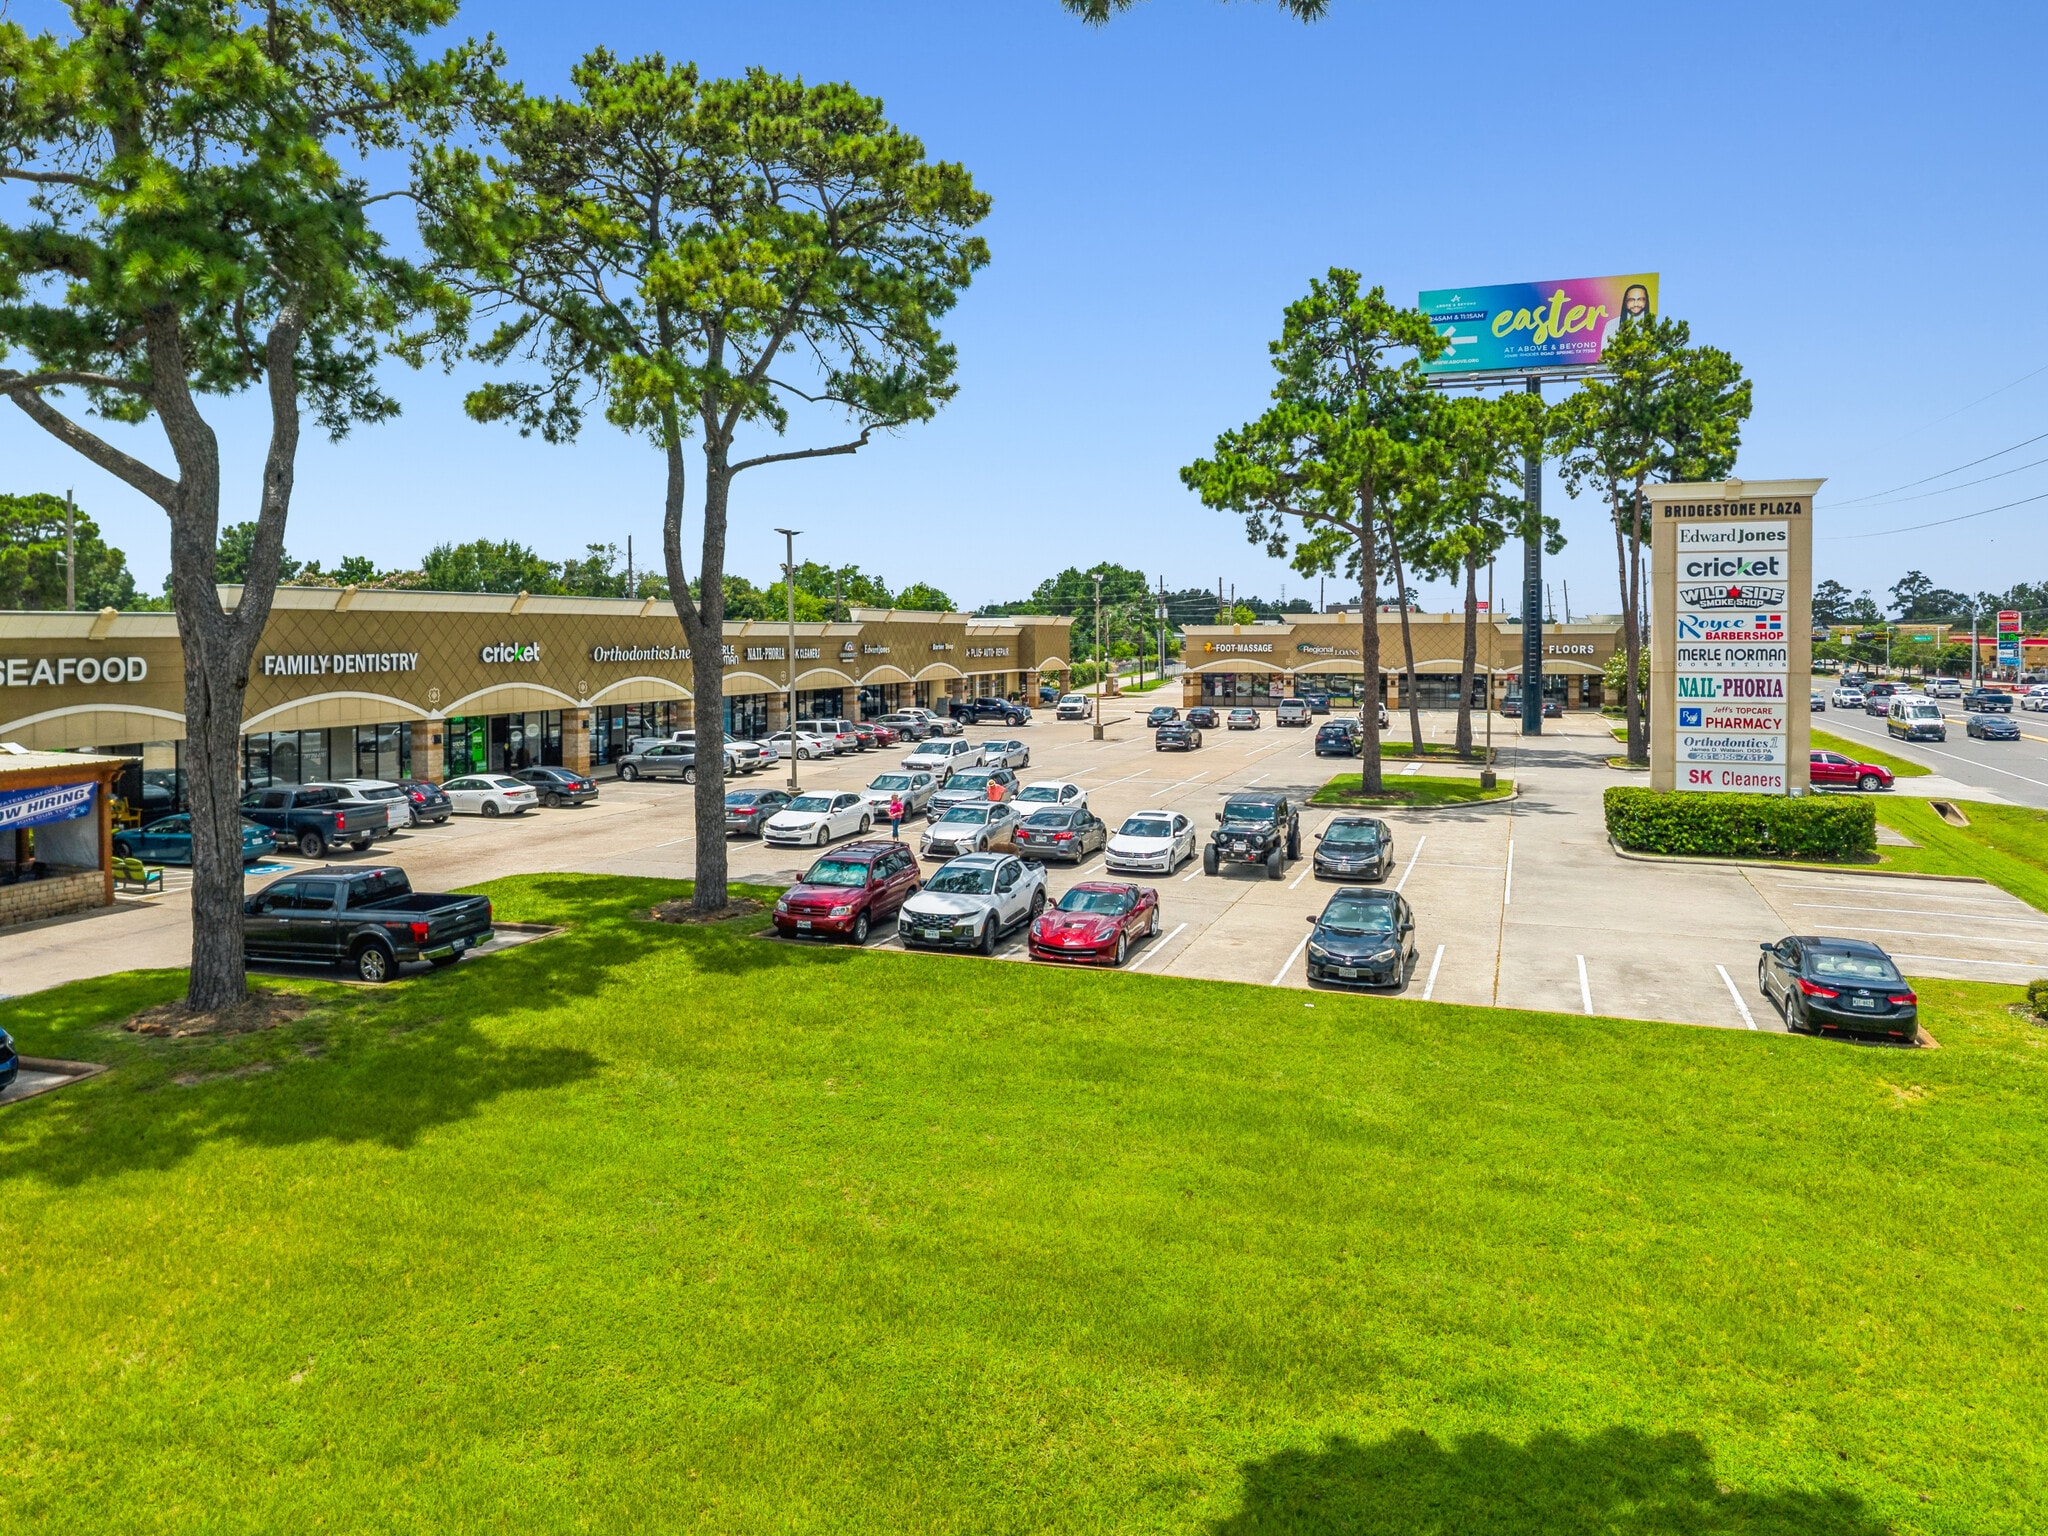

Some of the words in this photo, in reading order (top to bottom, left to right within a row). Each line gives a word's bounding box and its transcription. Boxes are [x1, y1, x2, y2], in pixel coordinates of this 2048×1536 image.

[1491, 289, 1608, 345] easter
[1518, 344, 1548, 352] ABOVE
[1560, 341, 1597, 350] BEYOND
[1664, 503, 1756, 518] BRIDGESTONE
[1760, 501, 1802, 515] PLAZA
[1680, 528, 1736, 543] Edward
[1737, 528, 1786, 543] Jones
[1686, 556, 1779, 577] cricket
[1680, 586, 1727, 603] WILD
[1741, 585, 1785, 603] SIDE
[1700, 599, 1735, 608] SMOKE
[1736, 599, 1764, 607] SHOP
[1678, 614, 1748, 639] Royce
[1705, 631, 1784, 640] BARBERSHOP
[482, 642, 540, 663] cricket
[594, 645, 691, 662] Orthodontics1.ne
[722, 645, 735, 655] RLE
[747, 647, 785, 660] NAIL-PHORIA
[1216, 644, 1236, 652] FOOT
[1237, 643, 1273, 652] MASSAGE
[1303, 645, 1334, 654] Regional
[1549, 644, 1594, 654] FLOORS
[723, 655, 739, 665] MAN
[1678, 649, 1721, 661] MERLE
[1725, 649, 1786, 661] NORMAN
[264, 654, 329, 676] FAMILY
[333, 652, 418, 674] DENTISTRY
[0, 656, 147, 686] EAFOOD
[1678, 677, 1783, 698] NAIL-PHORIA
[1713, 706, 1733, 714] Jeff's
[1736, 707, 1773, 715] TOPCARE
[1705, 717, 1782, 730] PHARMACY
[1688, 769, 1713, 784] SK
[1722, 770, 1781, 787] Cleaners
[24, 786, 62, 799] SEAFOOD
[27, 789, 85, 813] HIRING
[16, 816, 34, 825] JOIN
